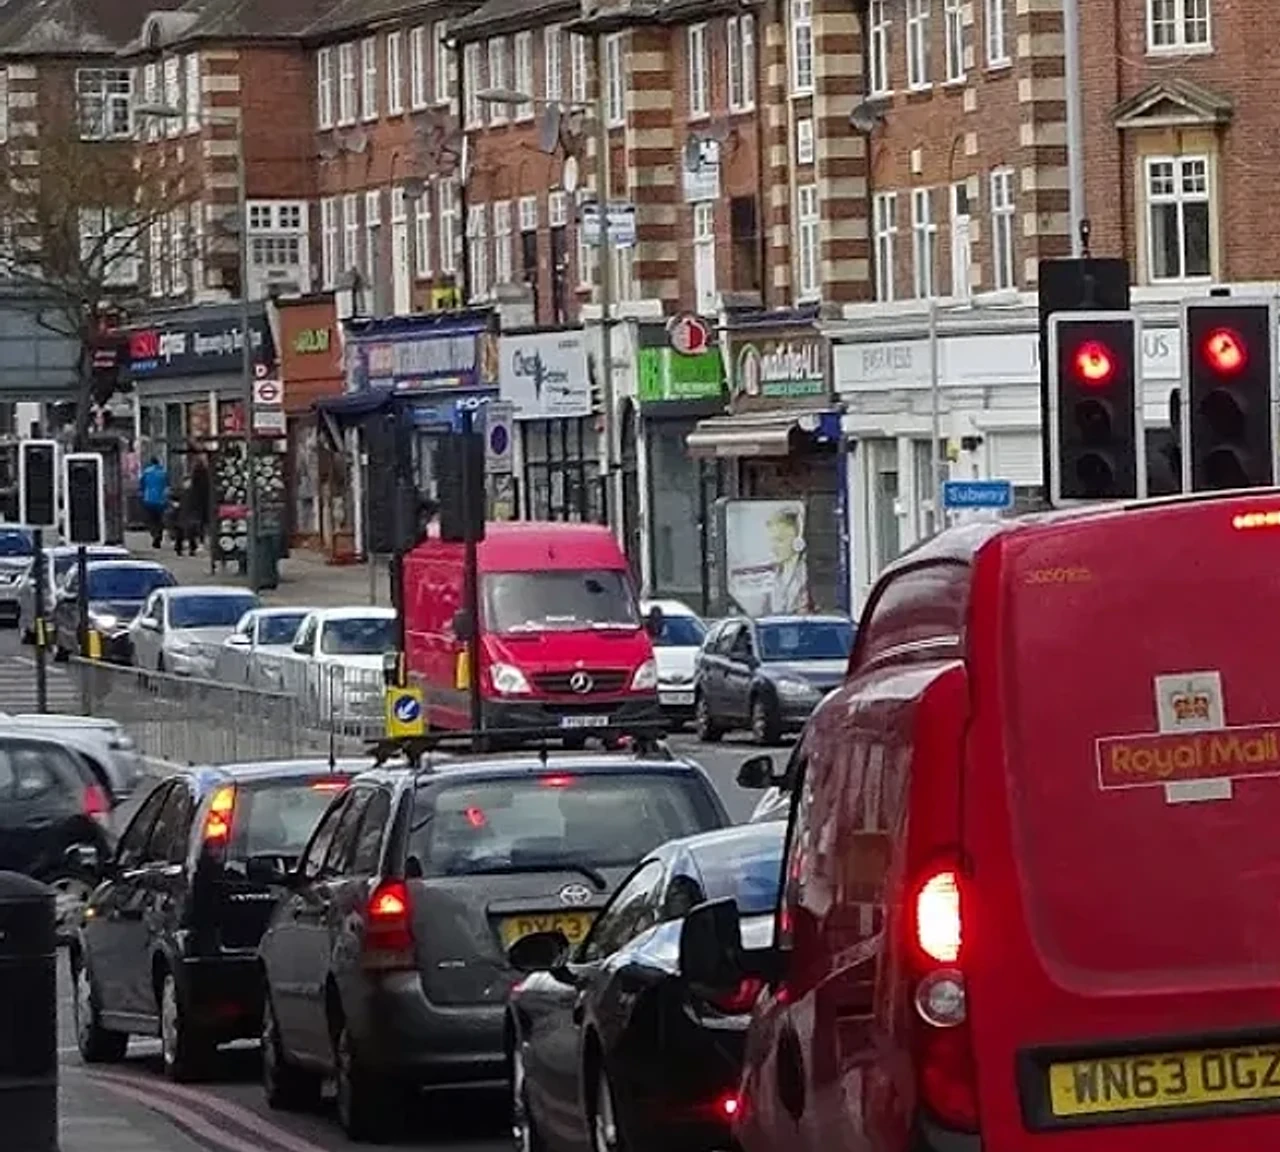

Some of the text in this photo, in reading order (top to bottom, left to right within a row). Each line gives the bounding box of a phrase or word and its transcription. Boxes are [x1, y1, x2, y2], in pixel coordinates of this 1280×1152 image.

[947, 481, 1008, 504] Subway
[1110, 731, 1279, 778] Royal Mail
[1072, 1056, 1188, 1104] WN63
